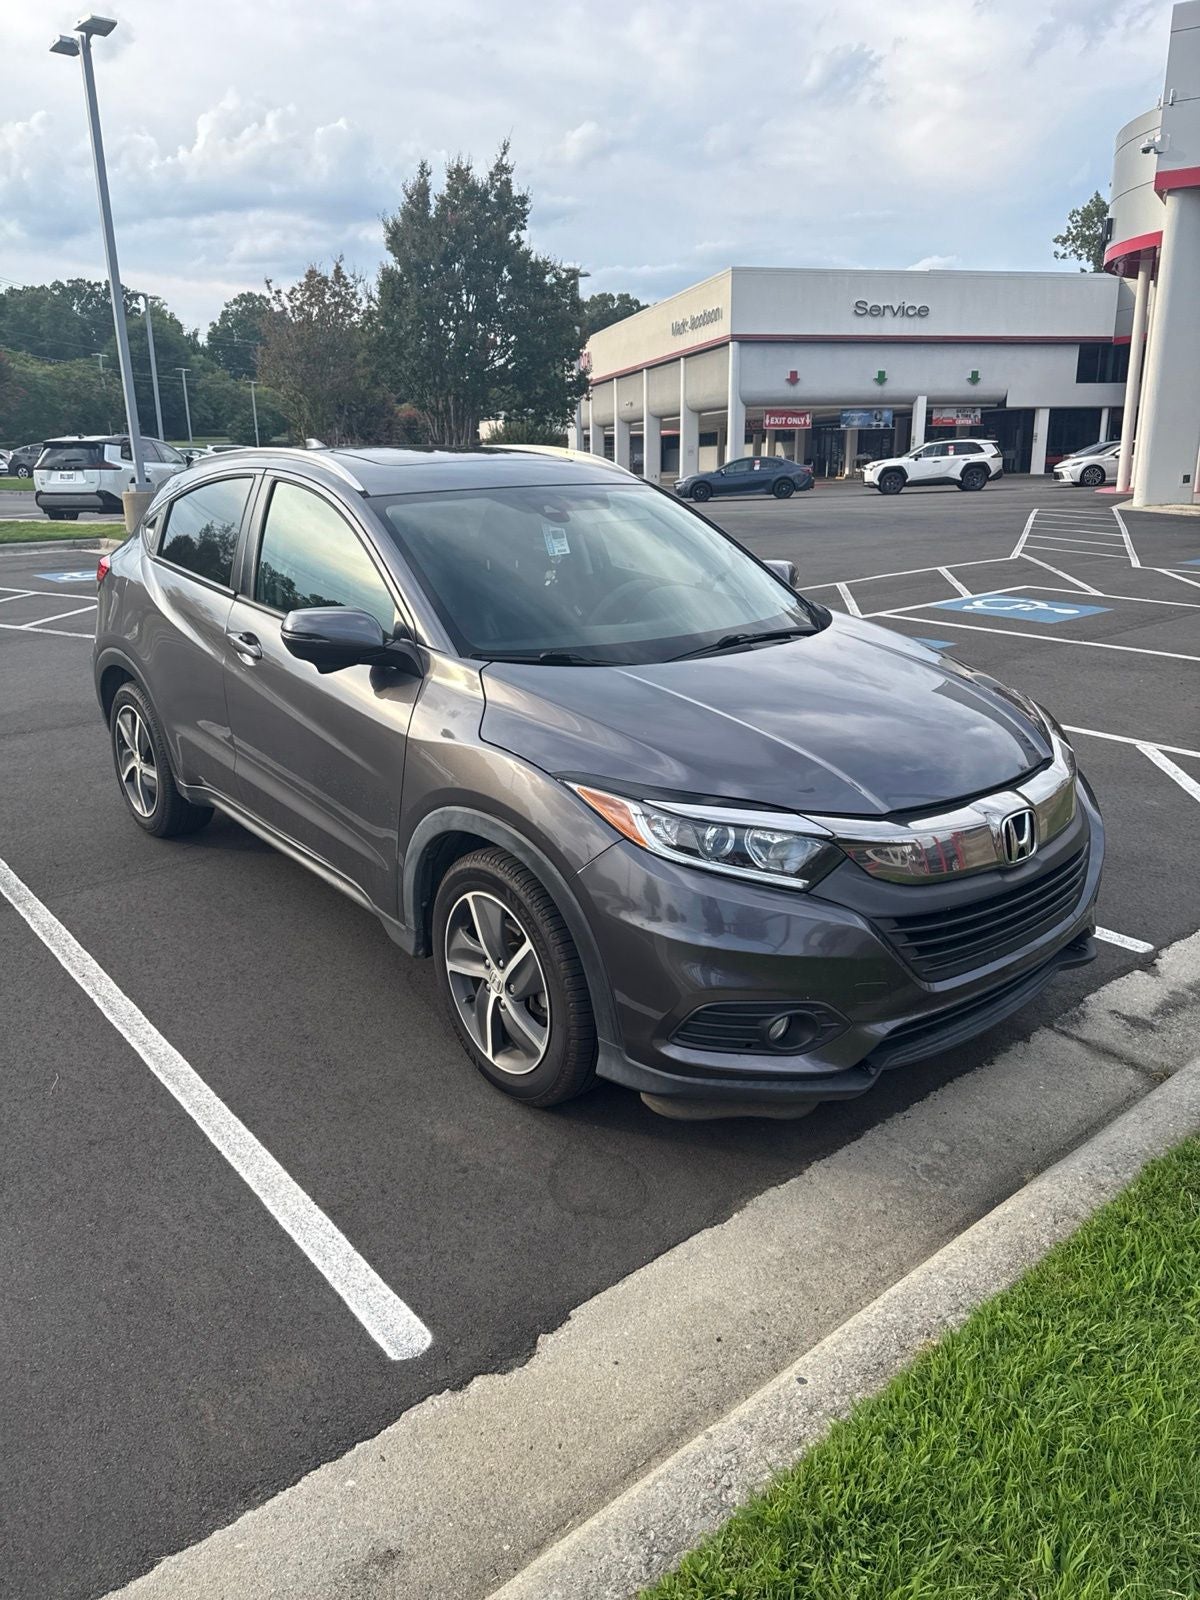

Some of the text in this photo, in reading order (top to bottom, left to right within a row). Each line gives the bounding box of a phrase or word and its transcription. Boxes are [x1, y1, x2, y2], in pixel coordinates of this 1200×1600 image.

[854, 300, 930, 318] Service
[770, 416, 805, 425] EXIT ONLY
